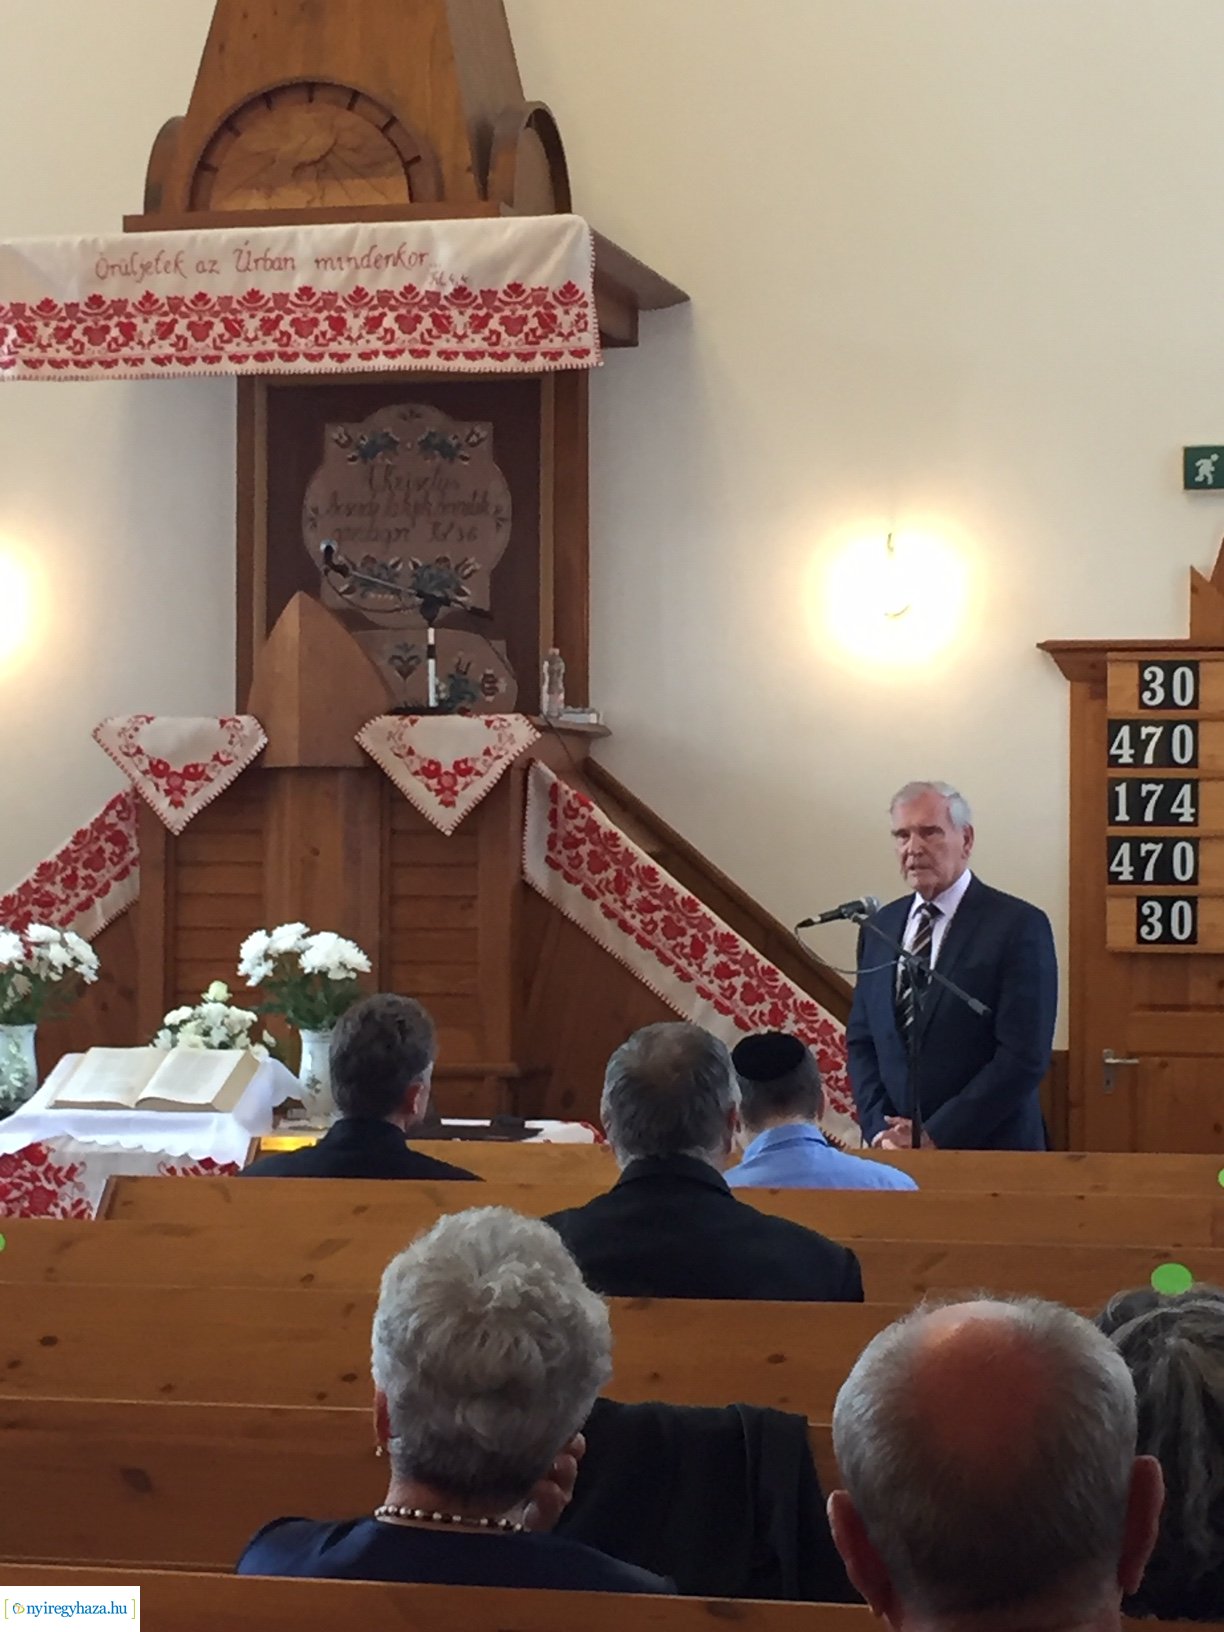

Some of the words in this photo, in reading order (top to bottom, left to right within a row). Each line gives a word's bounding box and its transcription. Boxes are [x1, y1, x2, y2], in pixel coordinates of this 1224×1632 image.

[196, 259, 220, 275] az
[233, 240, 296, 273] Úrban
[314, 242, 430, 272] mindenkor
[1141, 666, 1195, 707] 30
[1109, 724, 1195, 765] 470
[1114, 782, 1196, 822] 174
[1109, 841, 1195, 882] 470
[1140, 900, 1193, 941] 30
